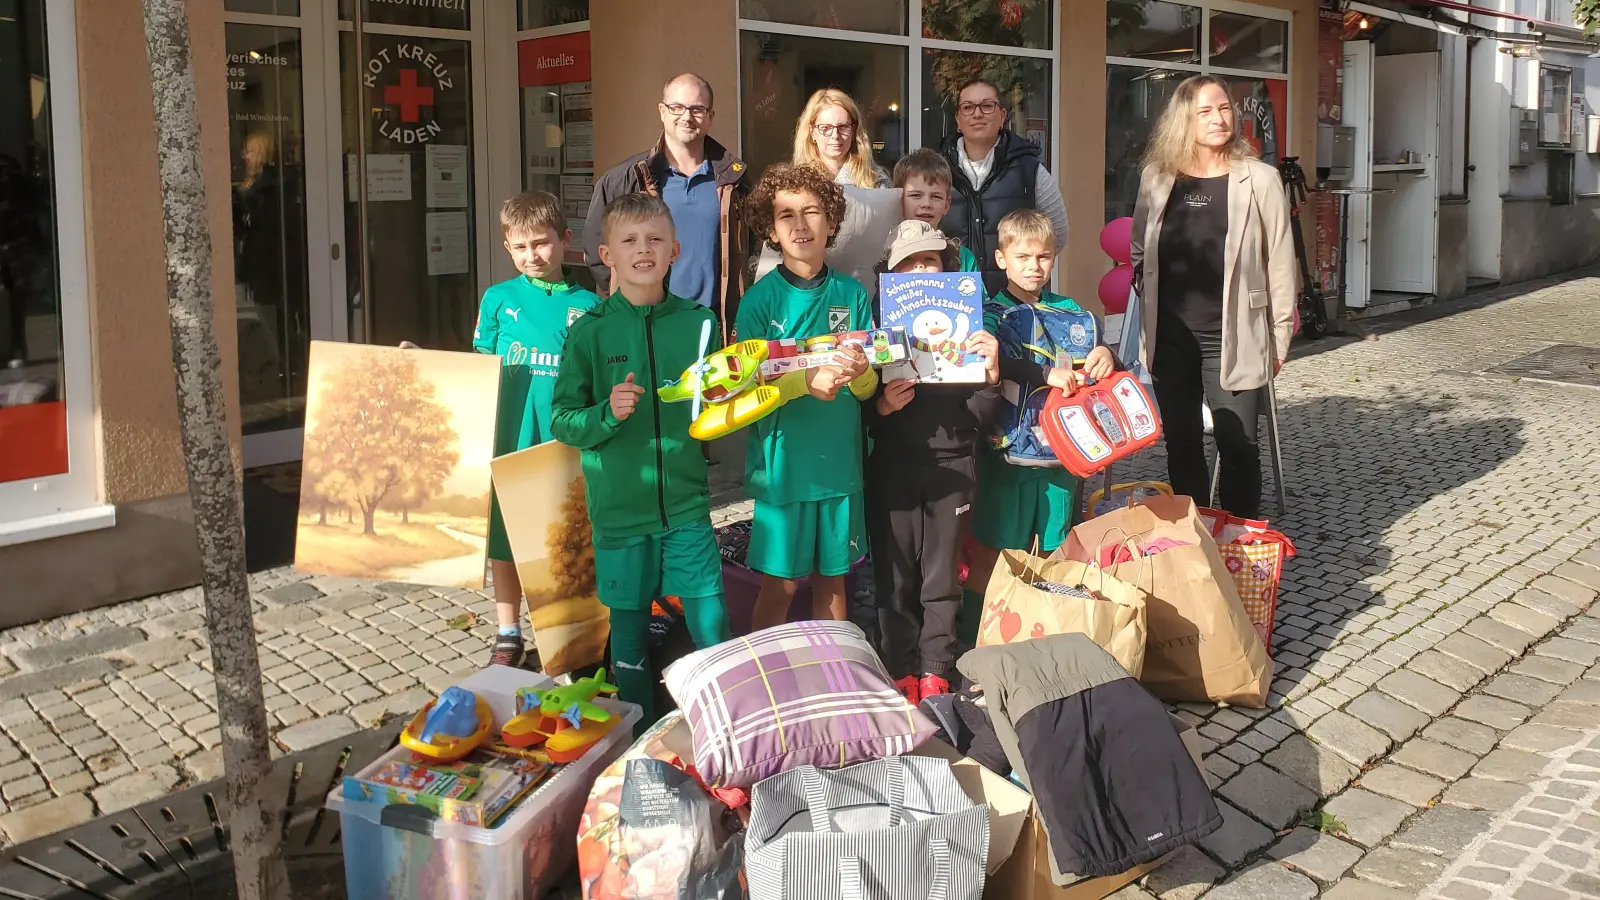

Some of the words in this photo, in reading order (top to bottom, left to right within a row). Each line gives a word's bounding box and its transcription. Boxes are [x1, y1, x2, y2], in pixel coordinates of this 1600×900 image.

[364, 48, 391, 88] ROT
[397, 44, 453, 91] KREUZ
[536, 53, 575, 70] Aktuelles
[1243, 97, 1272, 143] KREUZ
[379, 120, 441, 144] LADEN
[1184, 193, 1212, 202] PLAIN
[886, 280, 945, 297] Schneemanns
[895, 288, 924, 304] weißer
[887, 294, 976, 322] Weihnachtszauber
[607, 354, 628, 365] JAKO
